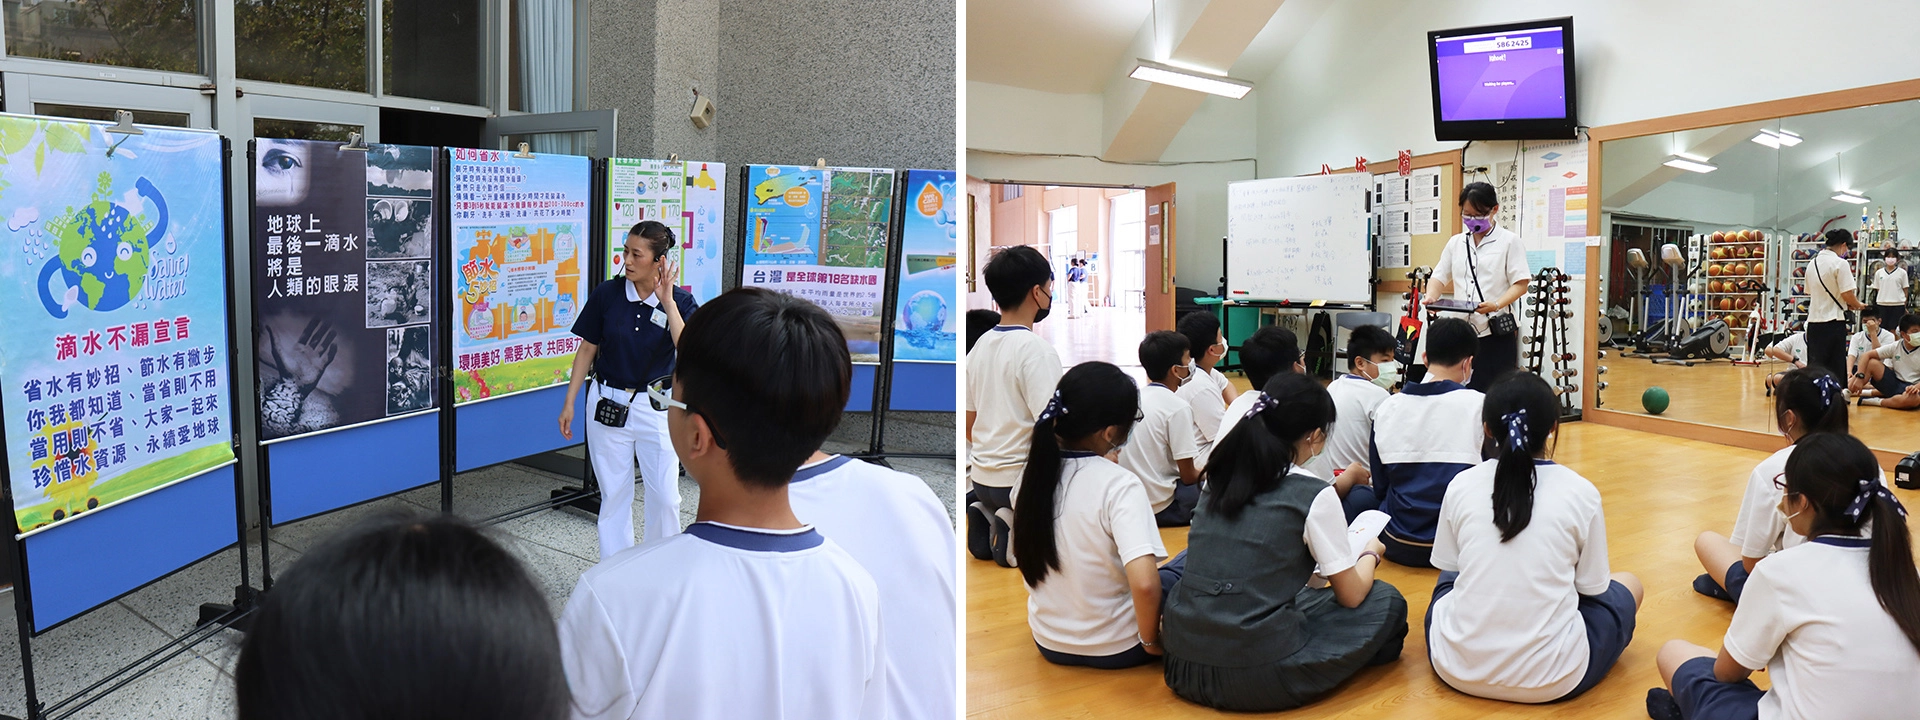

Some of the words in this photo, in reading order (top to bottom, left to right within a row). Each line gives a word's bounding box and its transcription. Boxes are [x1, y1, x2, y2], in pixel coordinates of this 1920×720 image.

[648, 176, 659, 190] 35
[669, 177, 681, 190] 140
[622, 203, 635, 217] 120
[645, 204, 657, 217] 75
[668, 204, 681, 217] 170
[266, 213, 322, 235] 地球上
[266, 233, 359, 256] 最後一滴水
[266, 256, 303, 278] 將是
[462, 256, 499, 285] 節水
[753, 269, 782, 284] 台灣
[786, 271, 877, 286] 是全球第18名缺水國
[267, 273, 360, 299] 人類的眼淚
[465, 279, 498, 304] 5妙招
[55, 316, 191, 361] 滴水不漏宣言
[458, 349, 501, 371] 環境美好
[504, 341, 543, 364] 需要大家
[546, 337, 584, 356] 共同努力
[23, 345, 216, 403] 省水有妙招、節水有撇步
[26, 368, 217, 432] 你我都知道、當省則不用
[29, 393, 219, 462] 當用則不省、大家一起來
[32, 416, 221, 489] 珍惜水資源、永續愛地球
